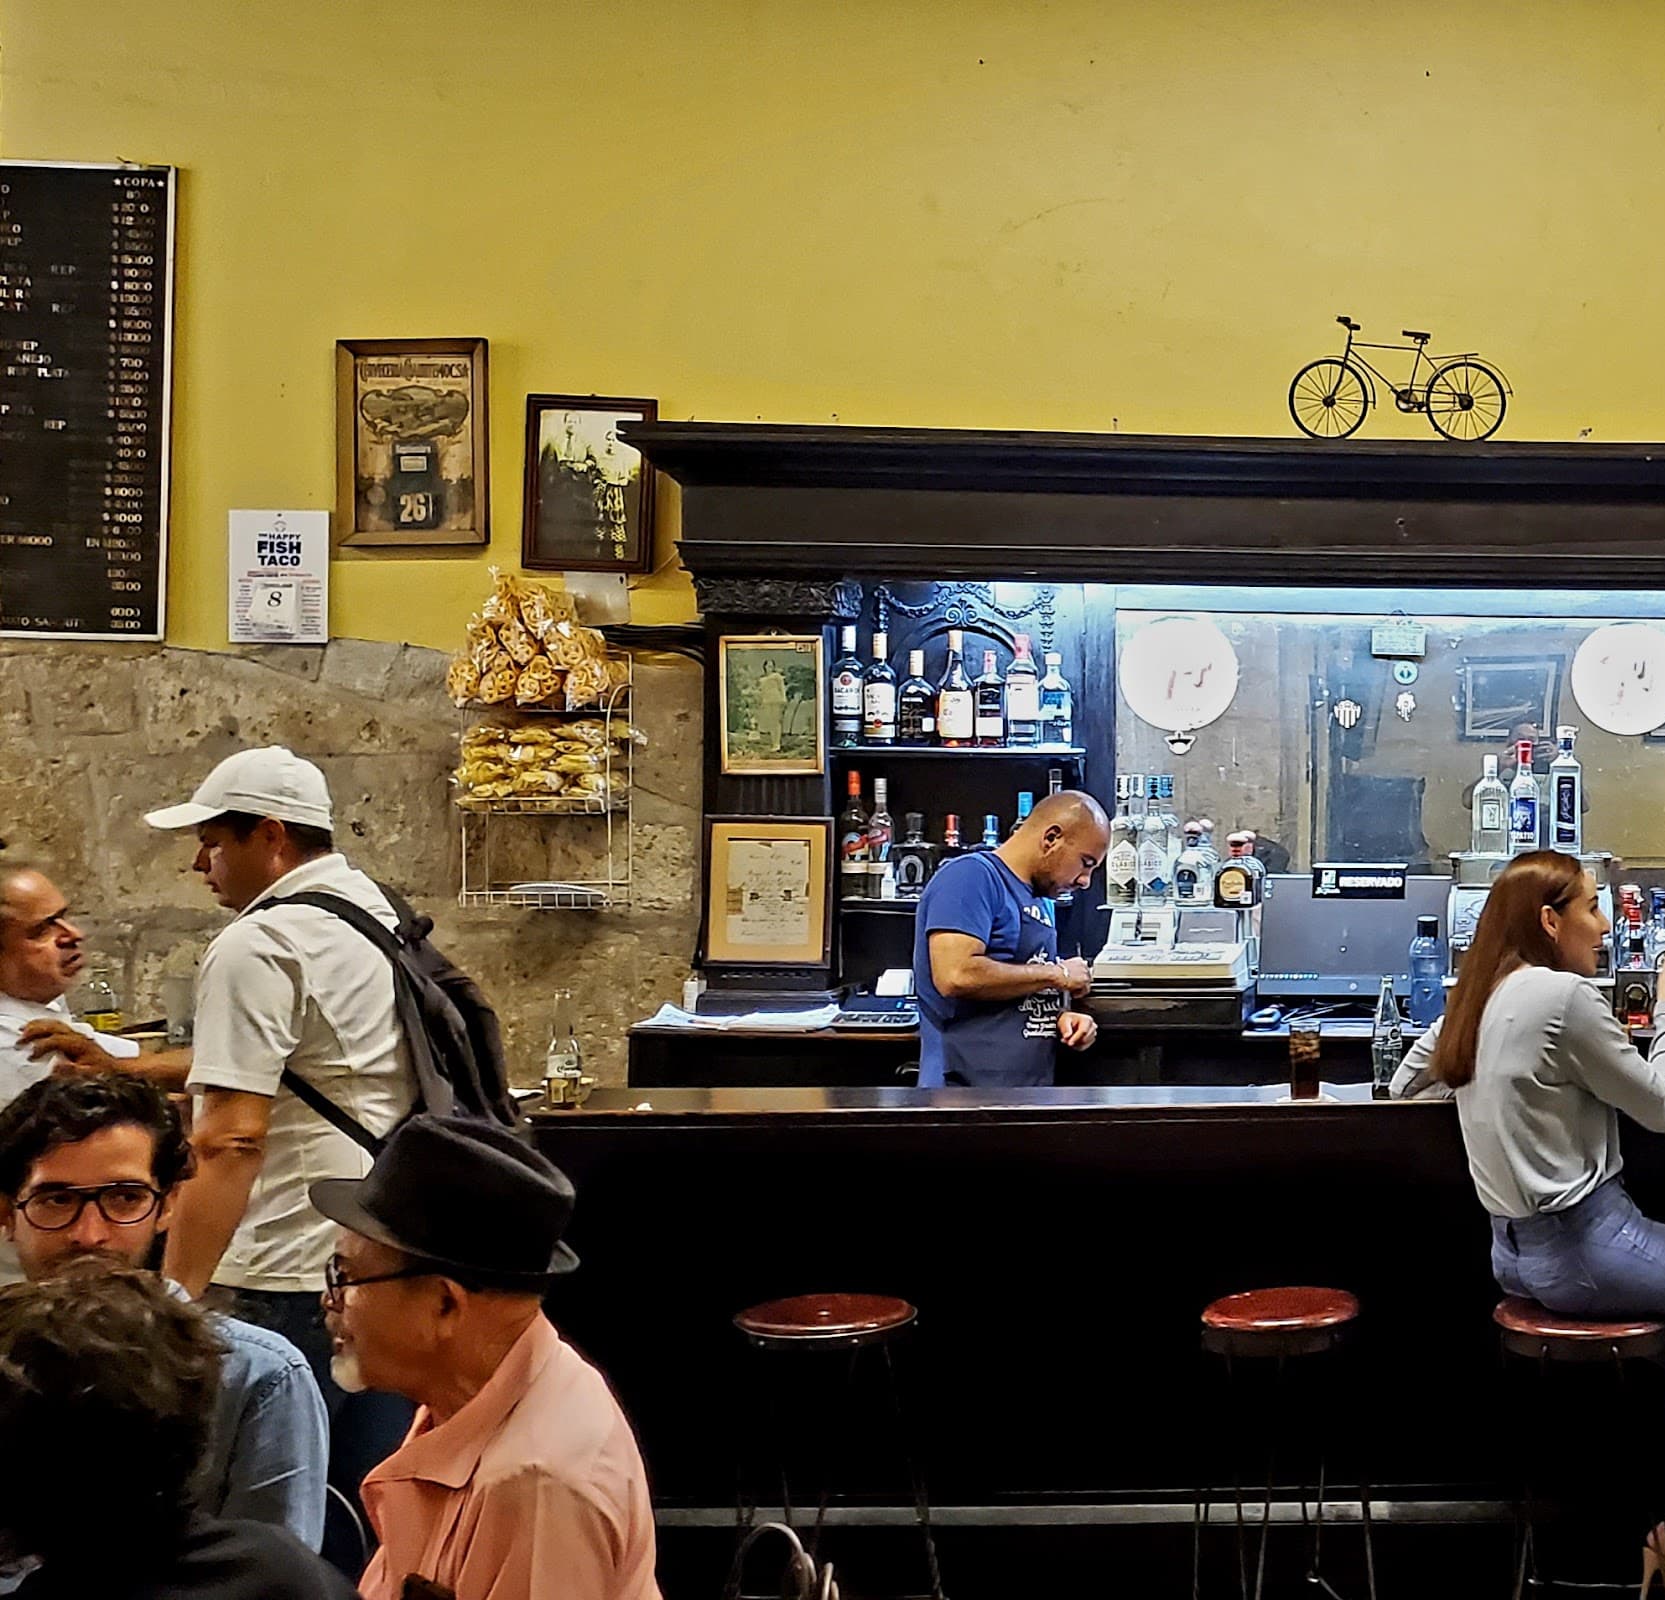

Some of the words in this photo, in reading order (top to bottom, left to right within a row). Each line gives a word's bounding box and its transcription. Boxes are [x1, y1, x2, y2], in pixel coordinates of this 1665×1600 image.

[123, 177, 155, 188] COPA
[400, 493, 426, 523] 26
[257, 540, 302, 554] FISH
[257, 555, 301, 567] TACO
[267, 591, 282, 607] 8
[1338, 876, 1403, 888] RESERVADO
